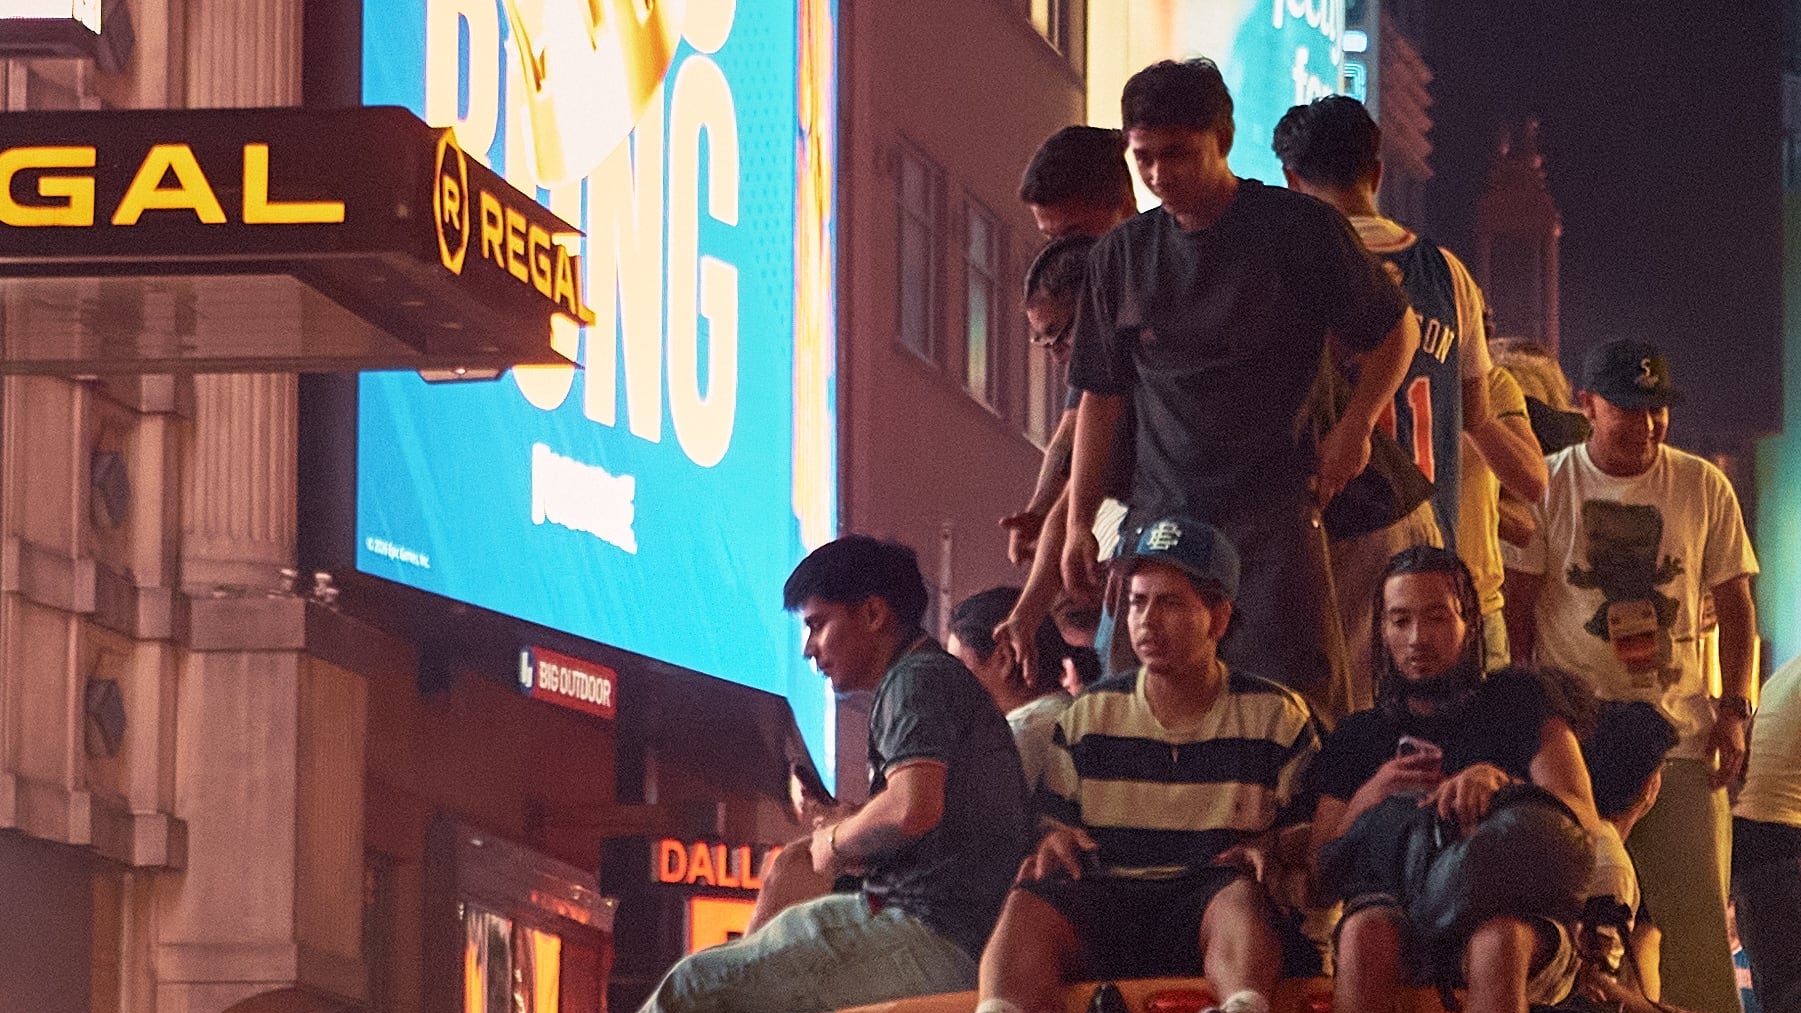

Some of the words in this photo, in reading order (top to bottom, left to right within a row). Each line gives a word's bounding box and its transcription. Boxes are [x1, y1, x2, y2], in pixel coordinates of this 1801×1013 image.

[479, 190, 595, 326] REGAL
[538, 660, 560, 692] BIG
[559, 667, 612, 708] OUTDOOR
